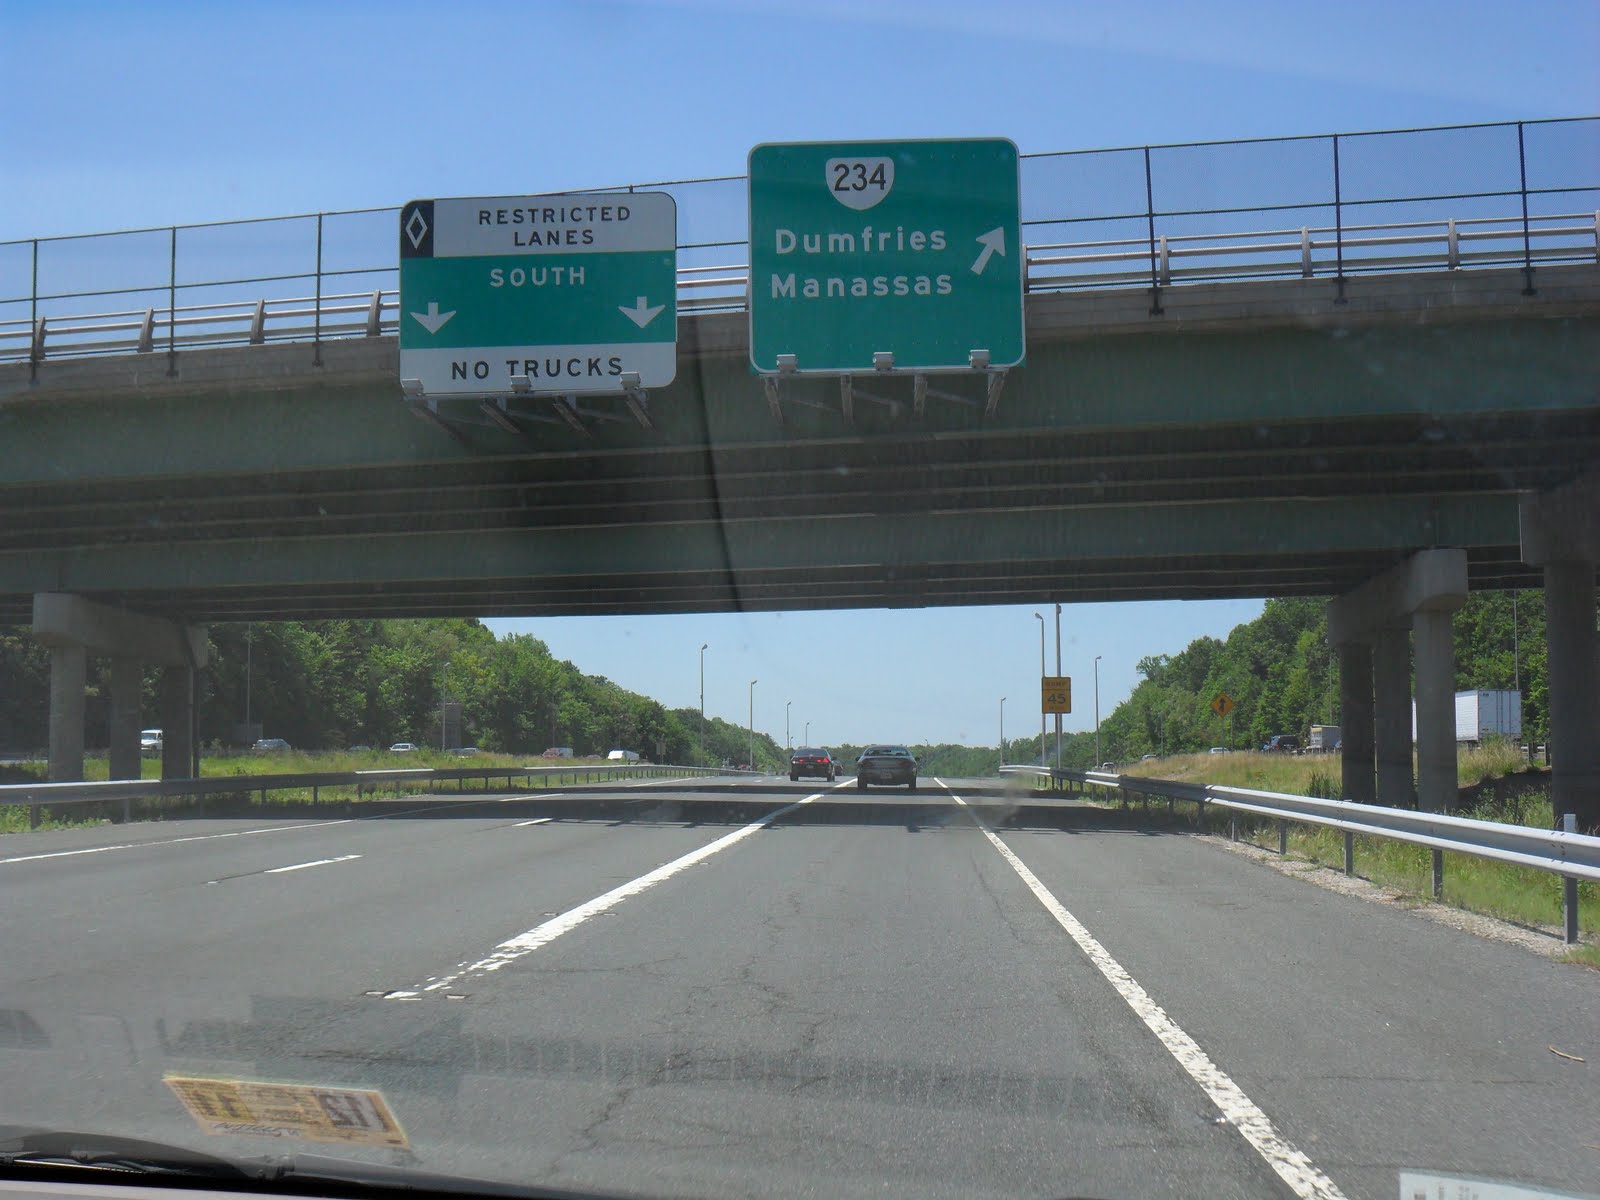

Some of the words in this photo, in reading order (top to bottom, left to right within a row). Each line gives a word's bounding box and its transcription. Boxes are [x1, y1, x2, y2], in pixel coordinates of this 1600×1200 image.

[833, 163, 887, 192] 234
[478, 206, 631, 226] RESTRICTED
[513, 229, 594, 247] LANES
[775, 226, 947, 255] Dumfries
[489, 266, 586, 288] SOUTH
[771, 272, 953, 299] Manassas
[451, 360, 490, 380] NO
[506, 357, 623, 378] TRUCKS
[1048, 694, 1066, 704] 45
